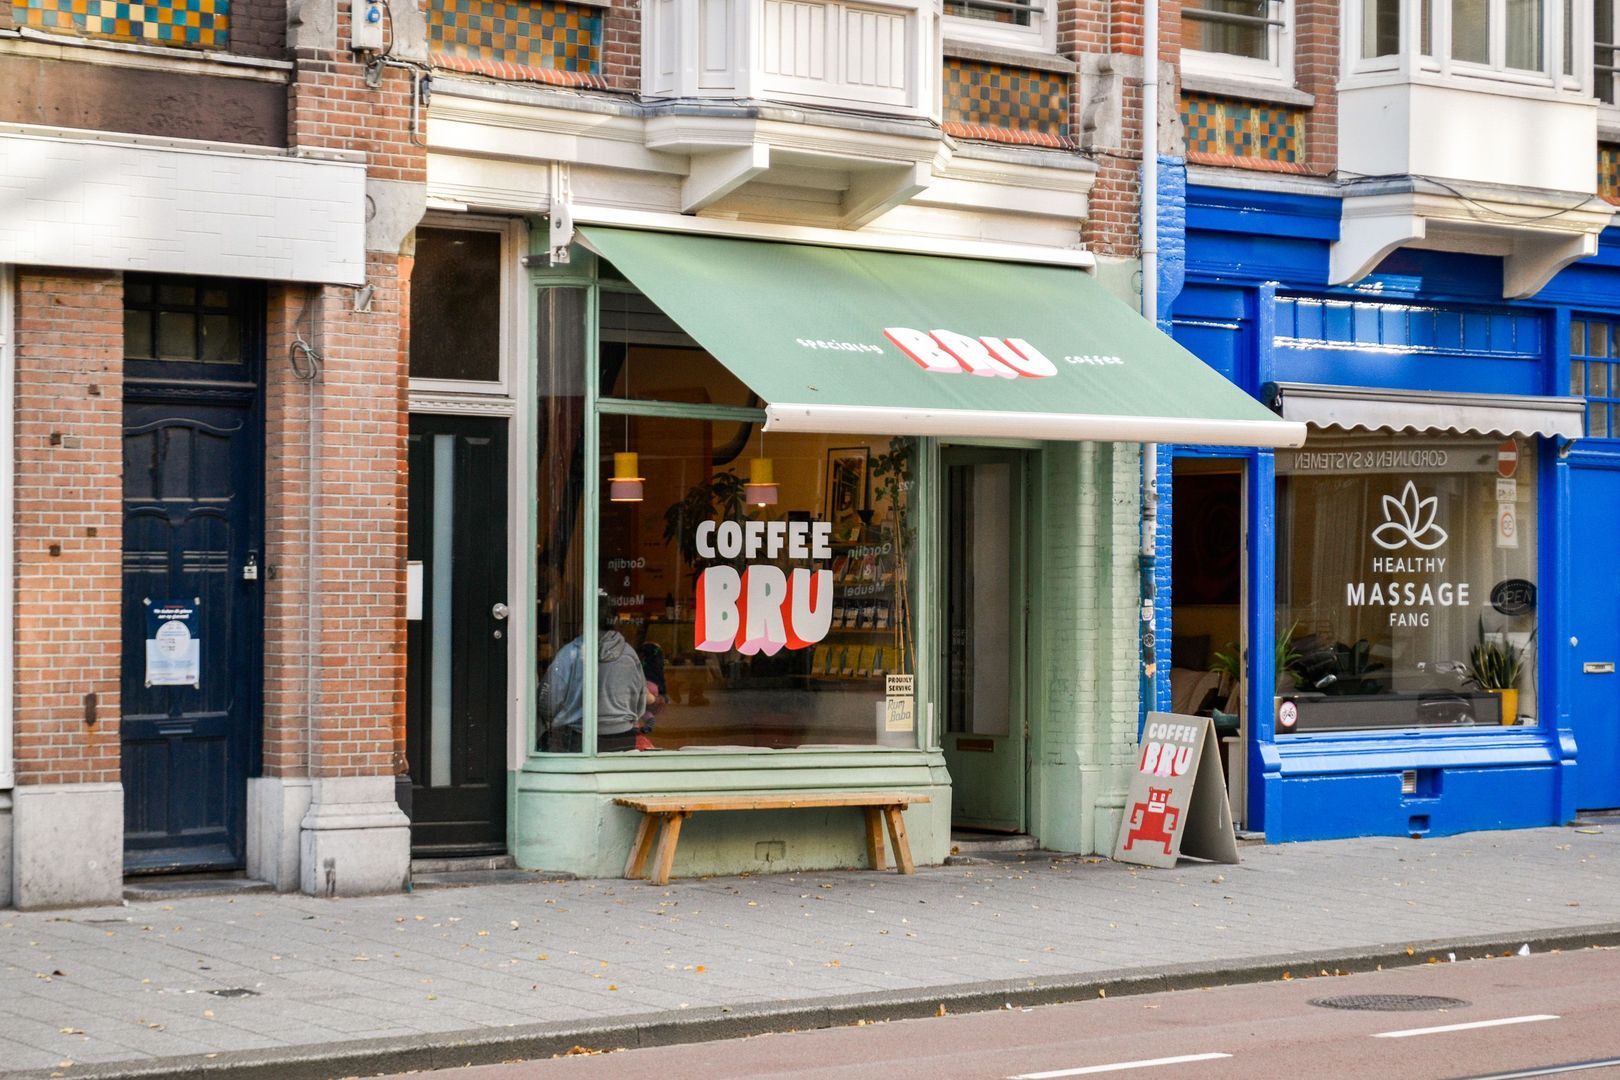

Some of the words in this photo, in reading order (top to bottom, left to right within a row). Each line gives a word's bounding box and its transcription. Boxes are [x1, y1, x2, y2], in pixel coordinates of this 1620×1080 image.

[795, 336, 884, 355] specialty
[882, 327, 1058, 380] BRU
[1064, 354, 1125, 366] coffee
[695, 520, 832, 559] COFFEE
[1373, 557, 1446, 573] HEALTHY
[1347, 582, 1470, 606] MASSAGE
[1497, 589, 1533, 606] OPEN
[695, 565, 833, 657] BRU
[1389, 612, 1430, 627] FANG
[888, 676, 912, 684] PROUDLY
[1149, 723, 1198, 743] COFFEE
[1140, 742, 1193, 777] BRU
